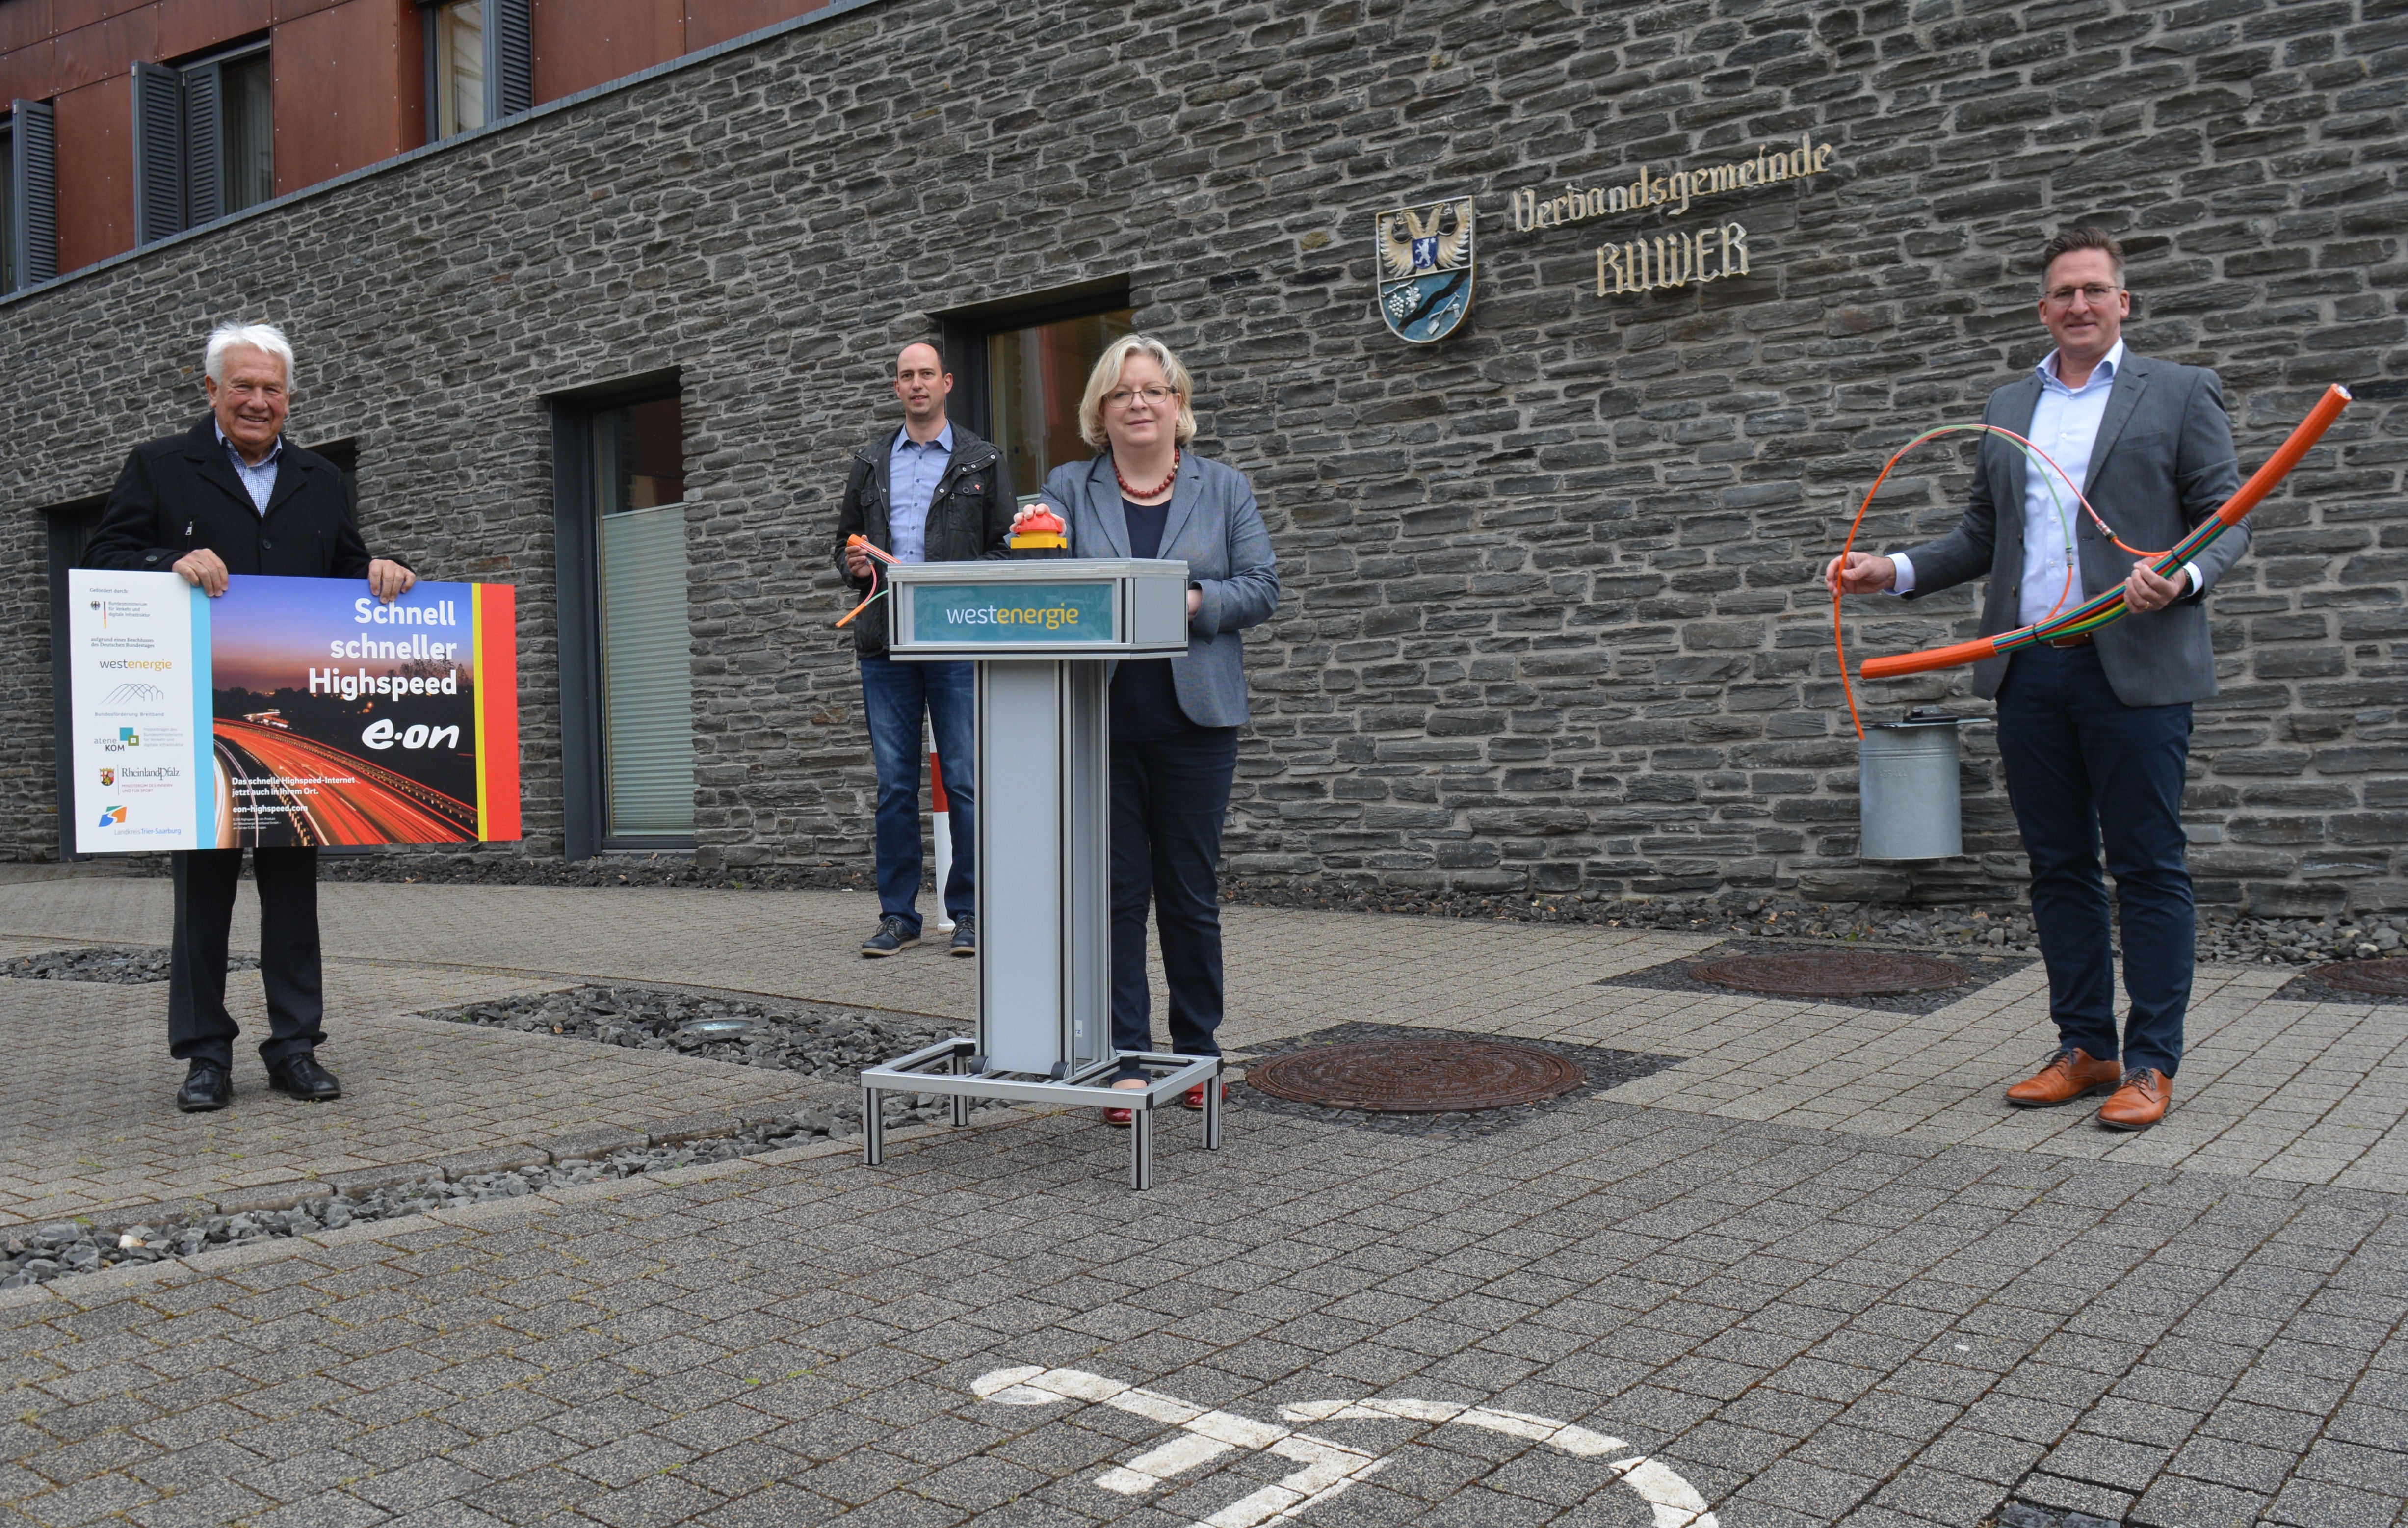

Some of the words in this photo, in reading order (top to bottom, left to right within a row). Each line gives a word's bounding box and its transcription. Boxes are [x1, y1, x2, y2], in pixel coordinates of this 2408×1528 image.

[1513, 132, 1832, 232] Verbandsgemeinde
[1597, 222, 1749, 297] RUWER
[355, 597, 456, 626] Schnell
[946, 602, 1079, 630] westenergie
[331, 633, 457, 660] schneller
[100, 659, 172, 672] westenergie
[309, 668, 457, 701] Highspeed
[232, 787, 250, 797] jetzt
[251, 787, 269, 795] auch
[271, 787, 278, 795] in
[280, 787, 302, 795] Ihrem
[303, 787, 319, 795] Ort.
[249, 776, 280, 785] schnelle
[281, 776, 355, 787] Highspeed-Internet
[233, 805, 308, 814] eon-highspeed.com
